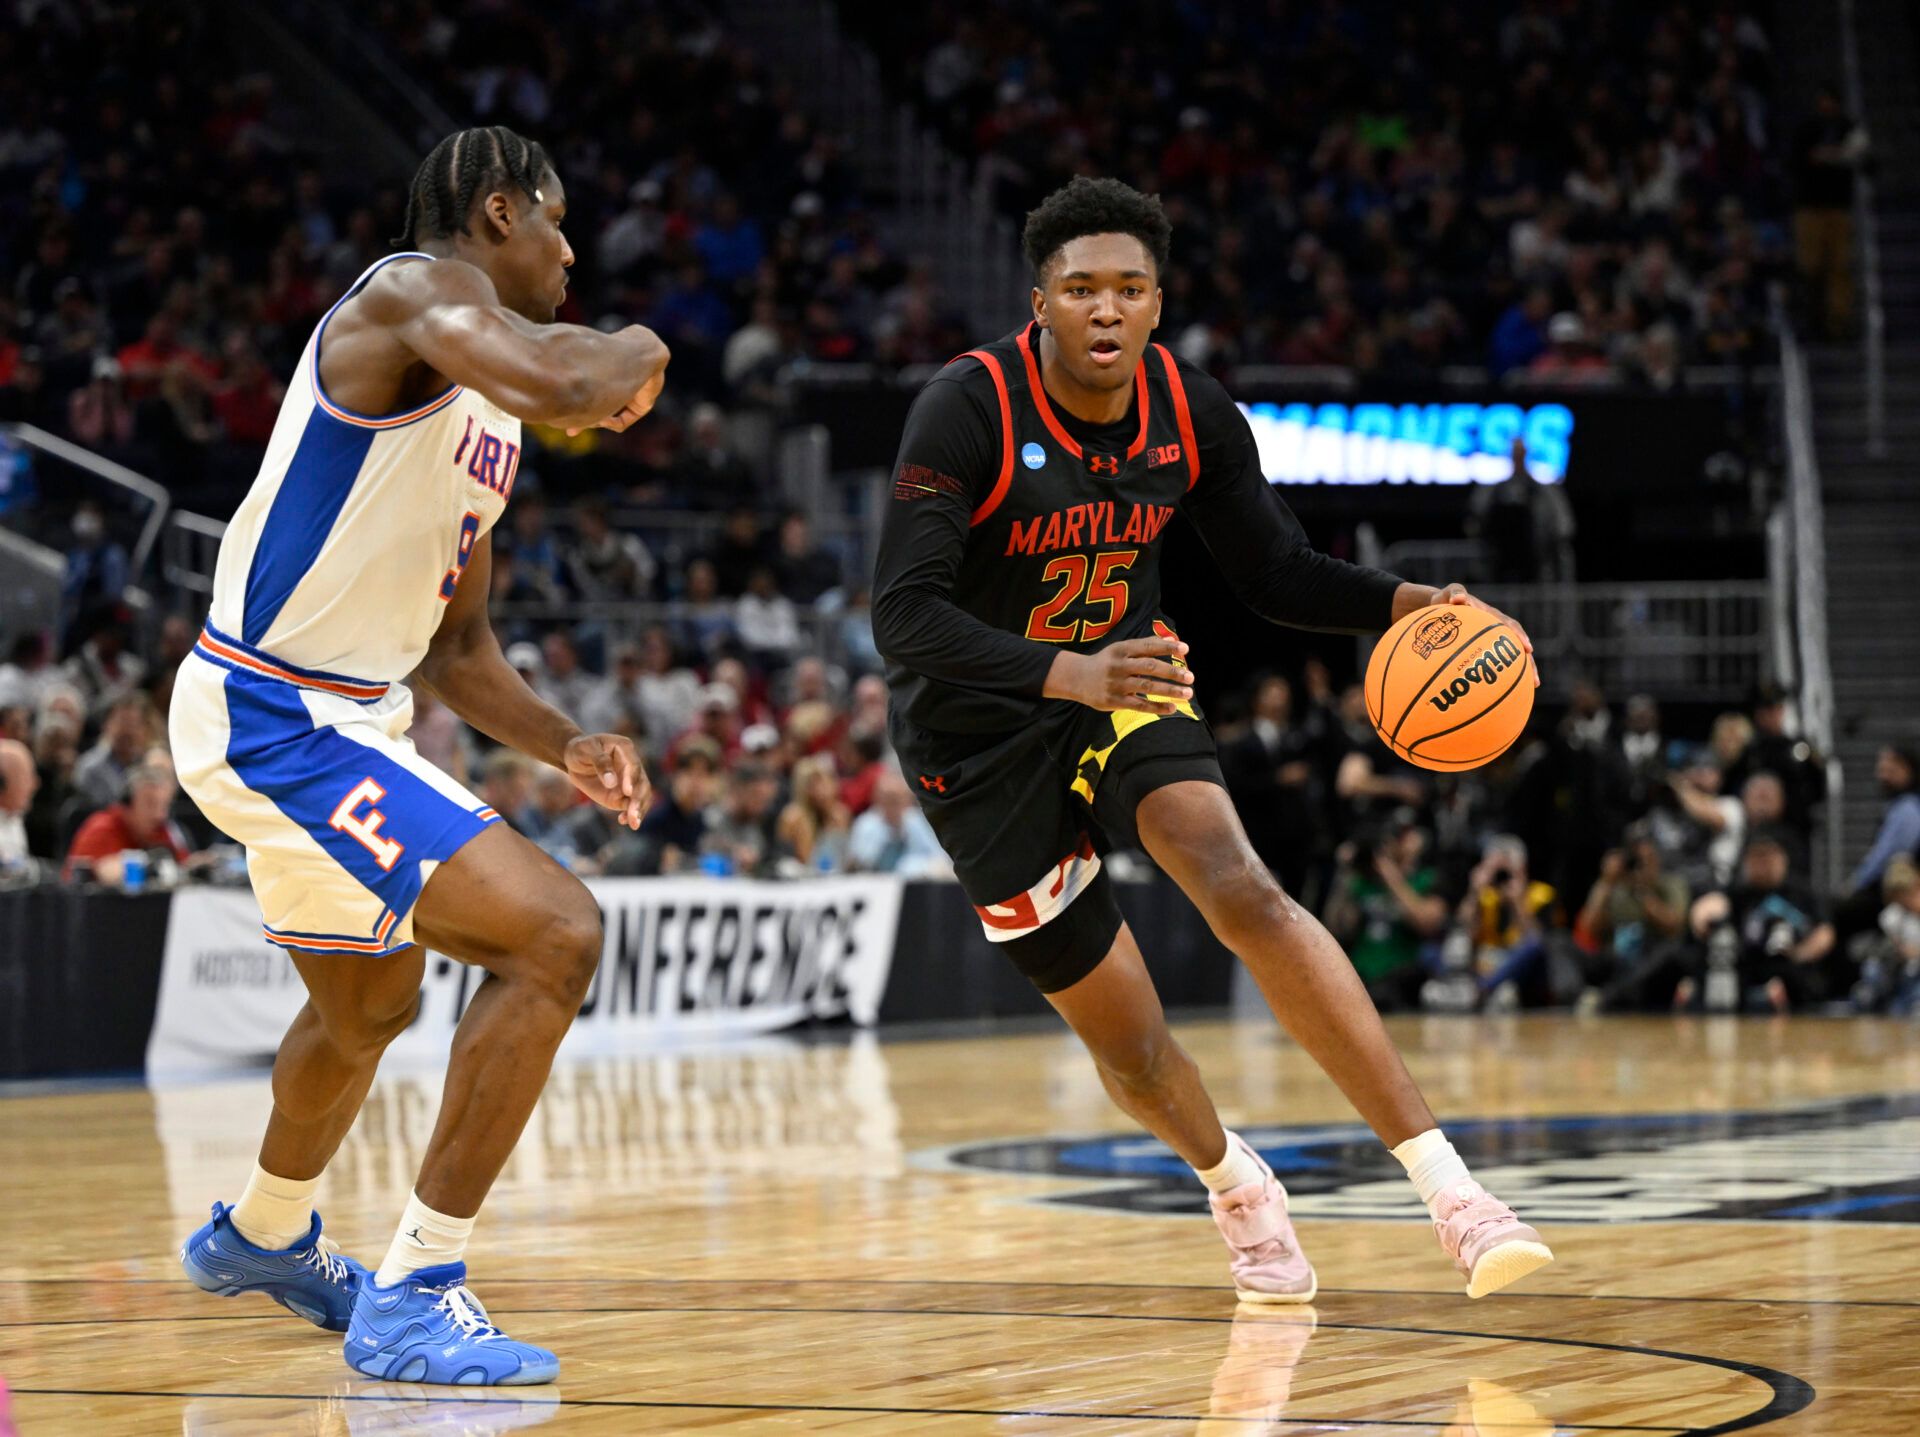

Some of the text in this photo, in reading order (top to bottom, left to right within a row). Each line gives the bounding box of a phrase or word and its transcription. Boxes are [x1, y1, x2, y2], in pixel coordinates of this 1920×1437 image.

[438, 511, 481, 602] 9
[1025, 550, 1139, 642] 25
[1430, 634, 1521, 712] Wilson
[327, 776, 405, 872] F
